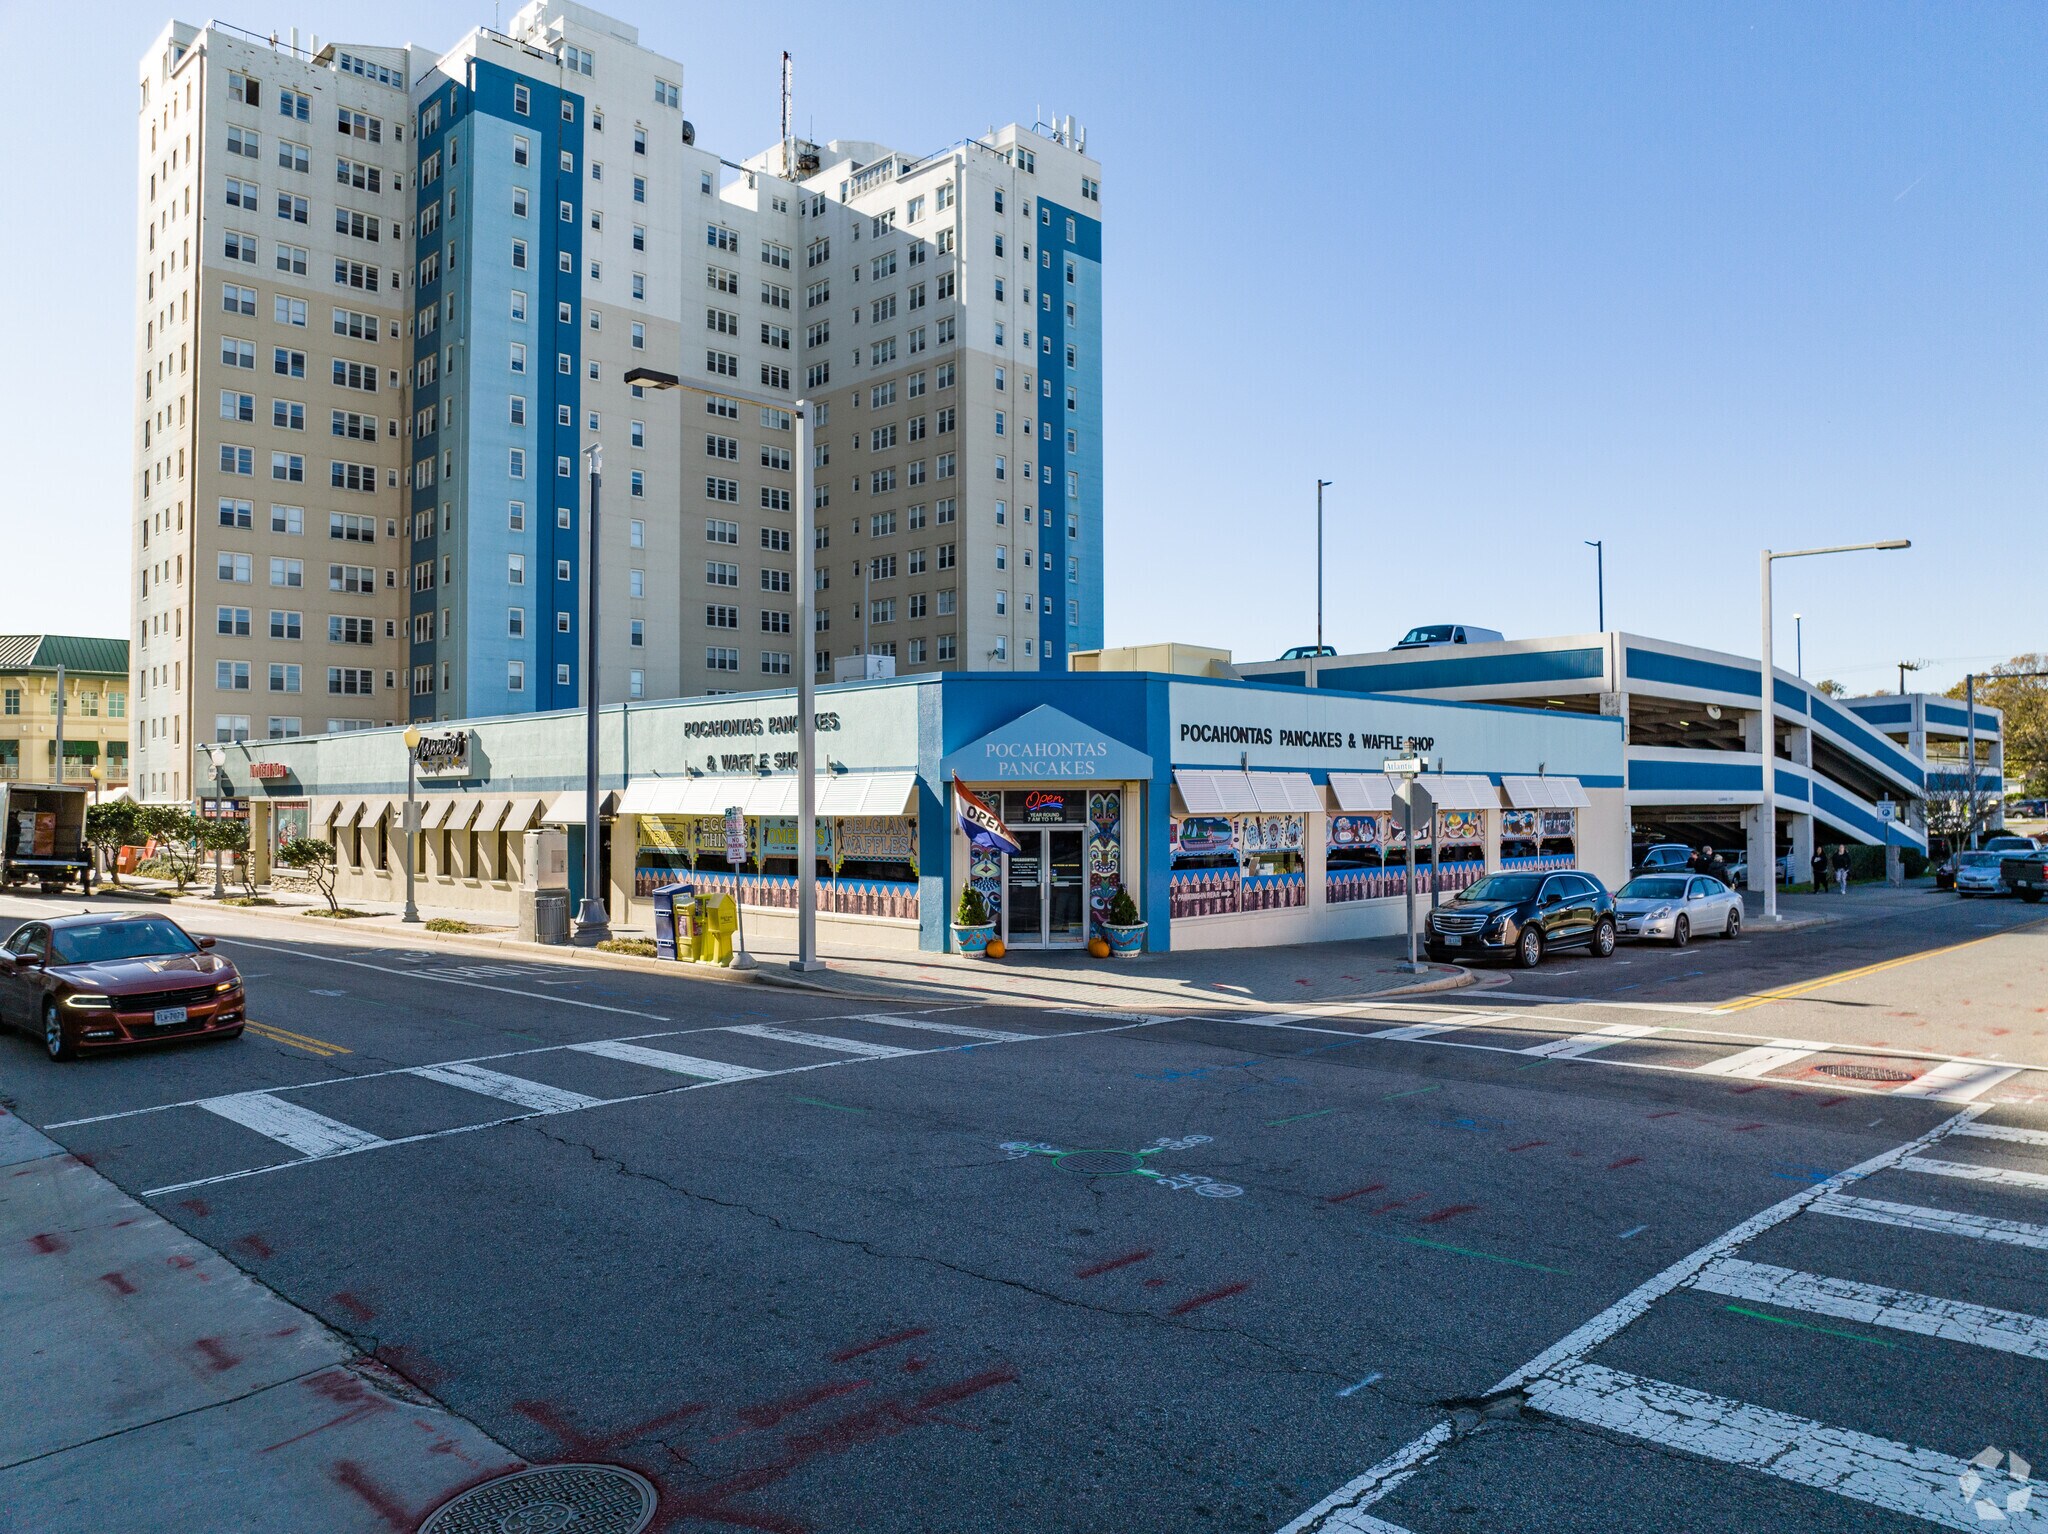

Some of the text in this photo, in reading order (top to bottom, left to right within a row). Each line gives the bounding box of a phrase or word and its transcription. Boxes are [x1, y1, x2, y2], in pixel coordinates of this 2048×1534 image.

[684, 712, 838, 736] POCAHONTAS PANCKES
[1180, 724, 1434, 751] POCAHONTAS PANCAKES & WAFFLE SHOP
[985, 742, 1108, 758] POCAHONTAS
[707, 751, 798, 771] & WAFFE SHO
[999, 761, 1096, 776] PANCAKES
[1025, 790, 1065, 810] Open
[844, 816, 908, 835] BELGIAN
[966, 805, 1006, 835] OPEN
[643, 830, 684, 846] WRAPS
[703, 833, 748, 848] THINS
[843, 836, 909, 855] WAFFLES
